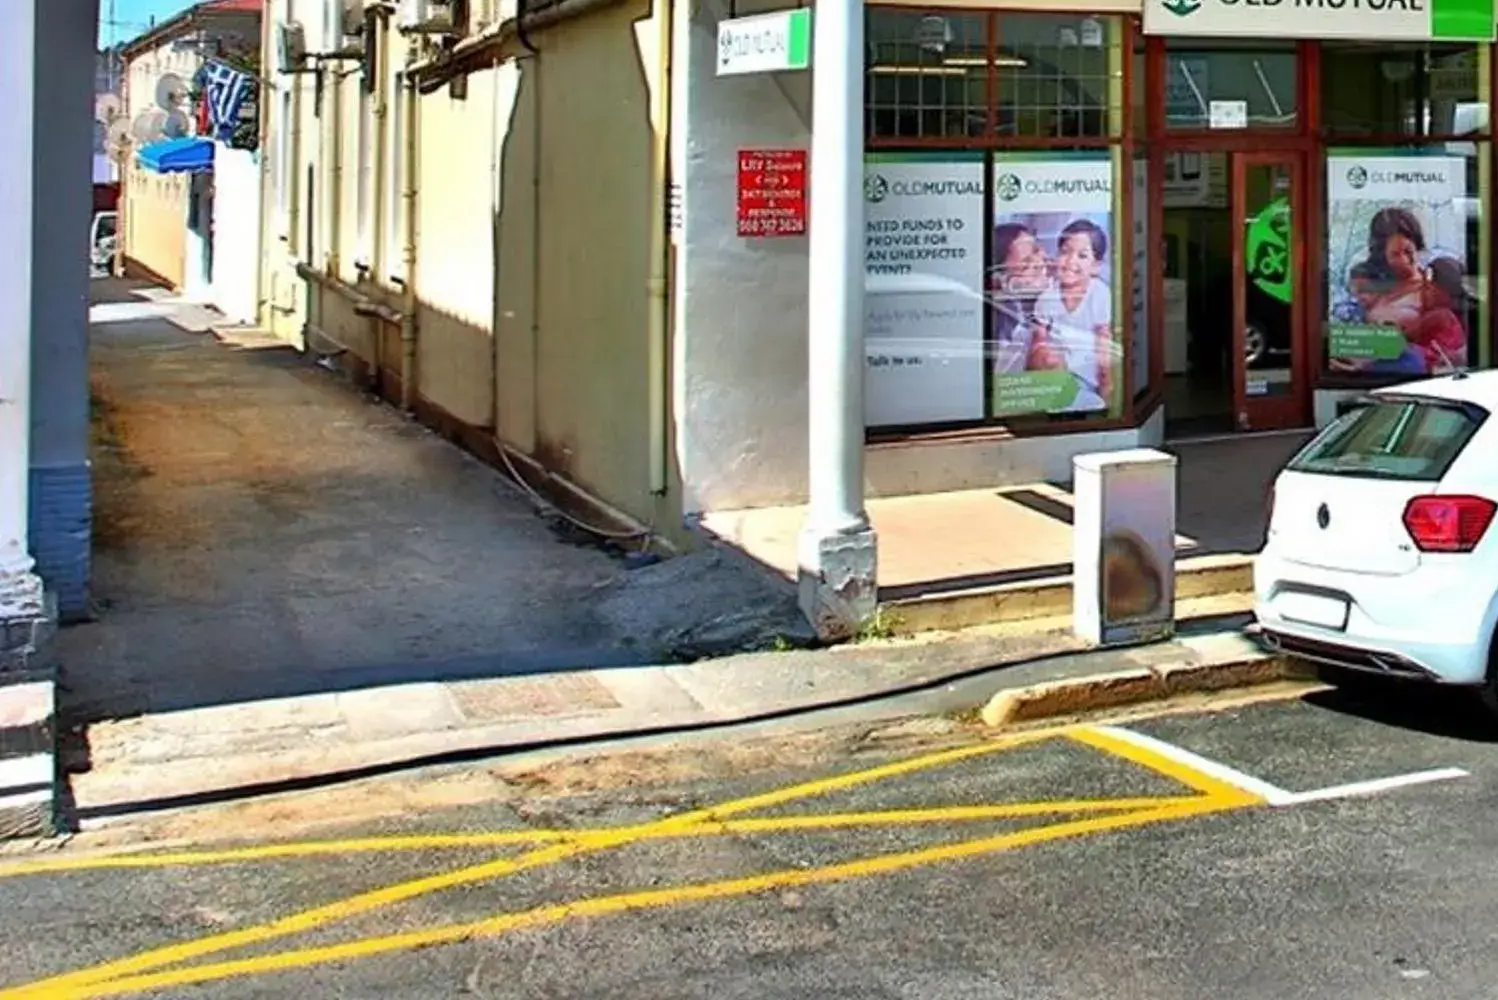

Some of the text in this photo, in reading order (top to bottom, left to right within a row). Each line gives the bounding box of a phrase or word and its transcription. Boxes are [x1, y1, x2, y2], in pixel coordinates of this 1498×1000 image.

[946, 218, 965, 231] TO
[866, 234, 920, 246] PROVIDE
[866, 249, 887, 261] AN
